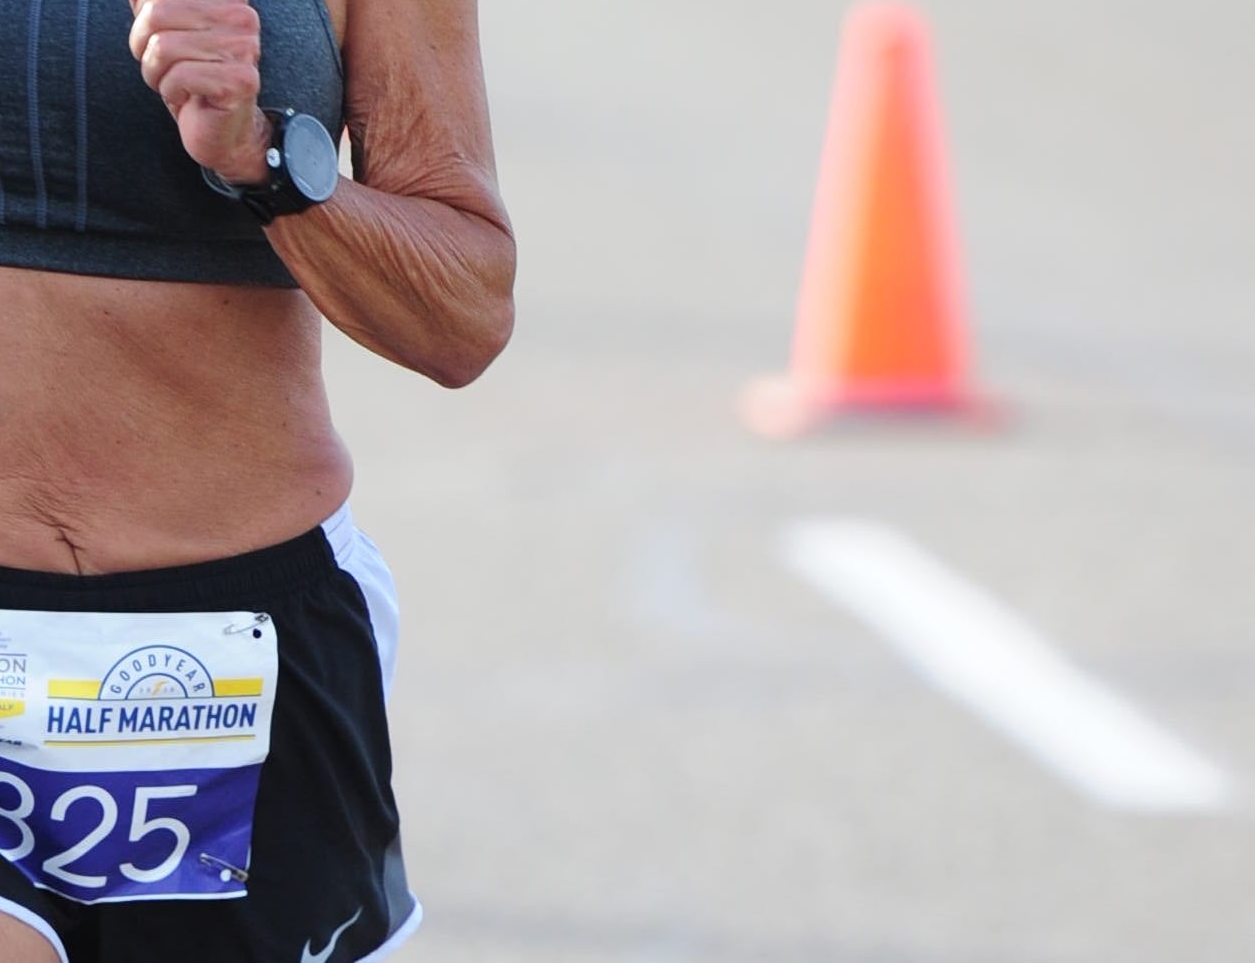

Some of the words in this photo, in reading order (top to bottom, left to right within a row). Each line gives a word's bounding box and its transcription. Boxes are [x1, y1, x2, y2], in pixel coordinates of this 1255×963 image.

[110, 653, 206, 694] GOODYEAR
[47, 705, 112, 734] HALF
[117, 703, 257, 733] MARATHON
